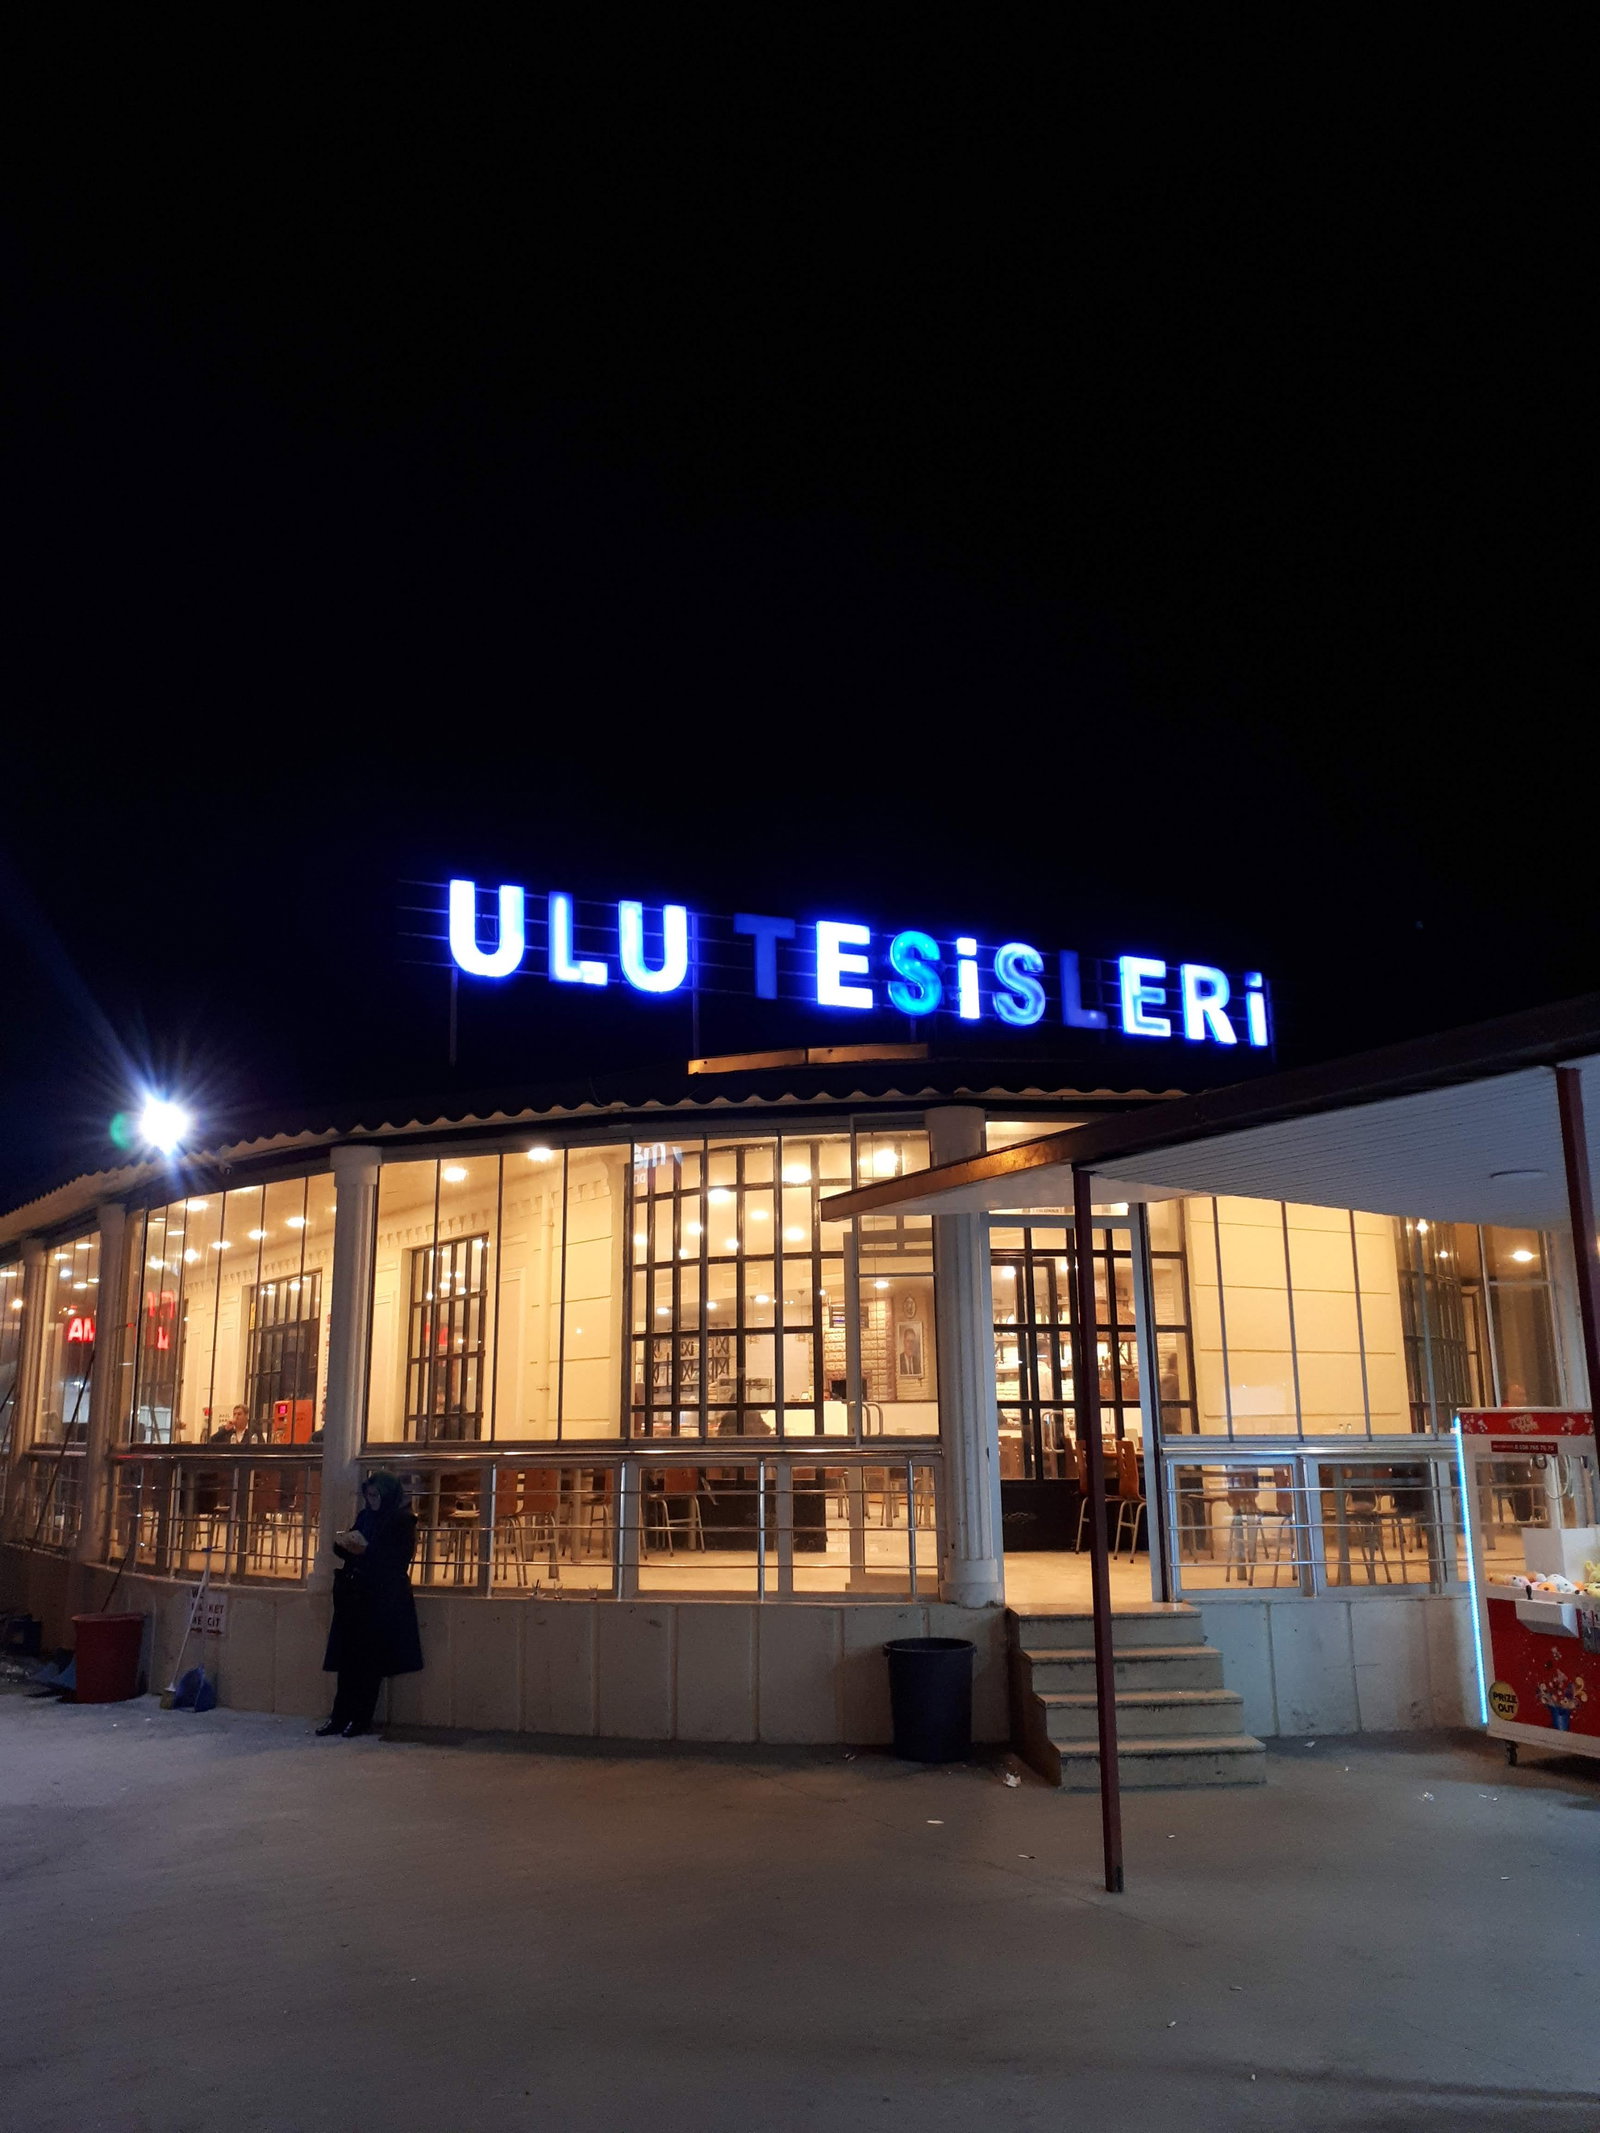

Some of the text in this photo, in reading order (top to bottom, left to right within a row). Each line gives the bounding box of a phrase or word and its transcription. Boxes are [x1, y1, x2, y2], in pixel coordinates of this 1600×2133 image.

[449, 879, 688, 993] ULU
[1493, 1692, 1517, 1703] PRIZE
[1498, 1703, 1514, 1713] OUT
